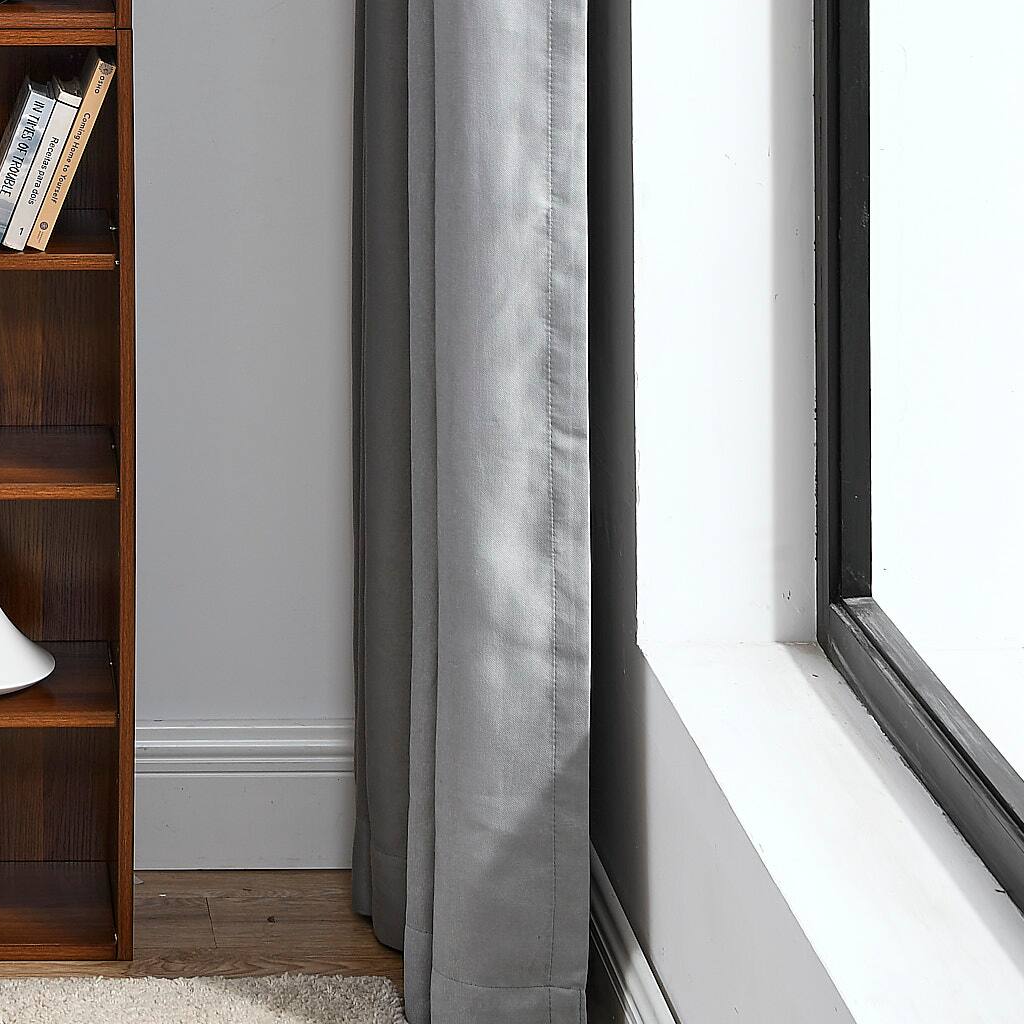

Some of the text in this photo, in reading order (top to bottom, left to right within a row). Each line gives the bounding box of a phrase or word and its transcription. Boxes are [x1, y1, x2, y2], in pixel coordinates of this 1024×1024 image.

[94, 75, 105, 94] OSHO
[0, 100, 46, 197] IN TIMES OF TROUBLE
[27, 136, 60, 205] Receitas para dois
[51, 112, 91, 204] Coming Home to Yourself
